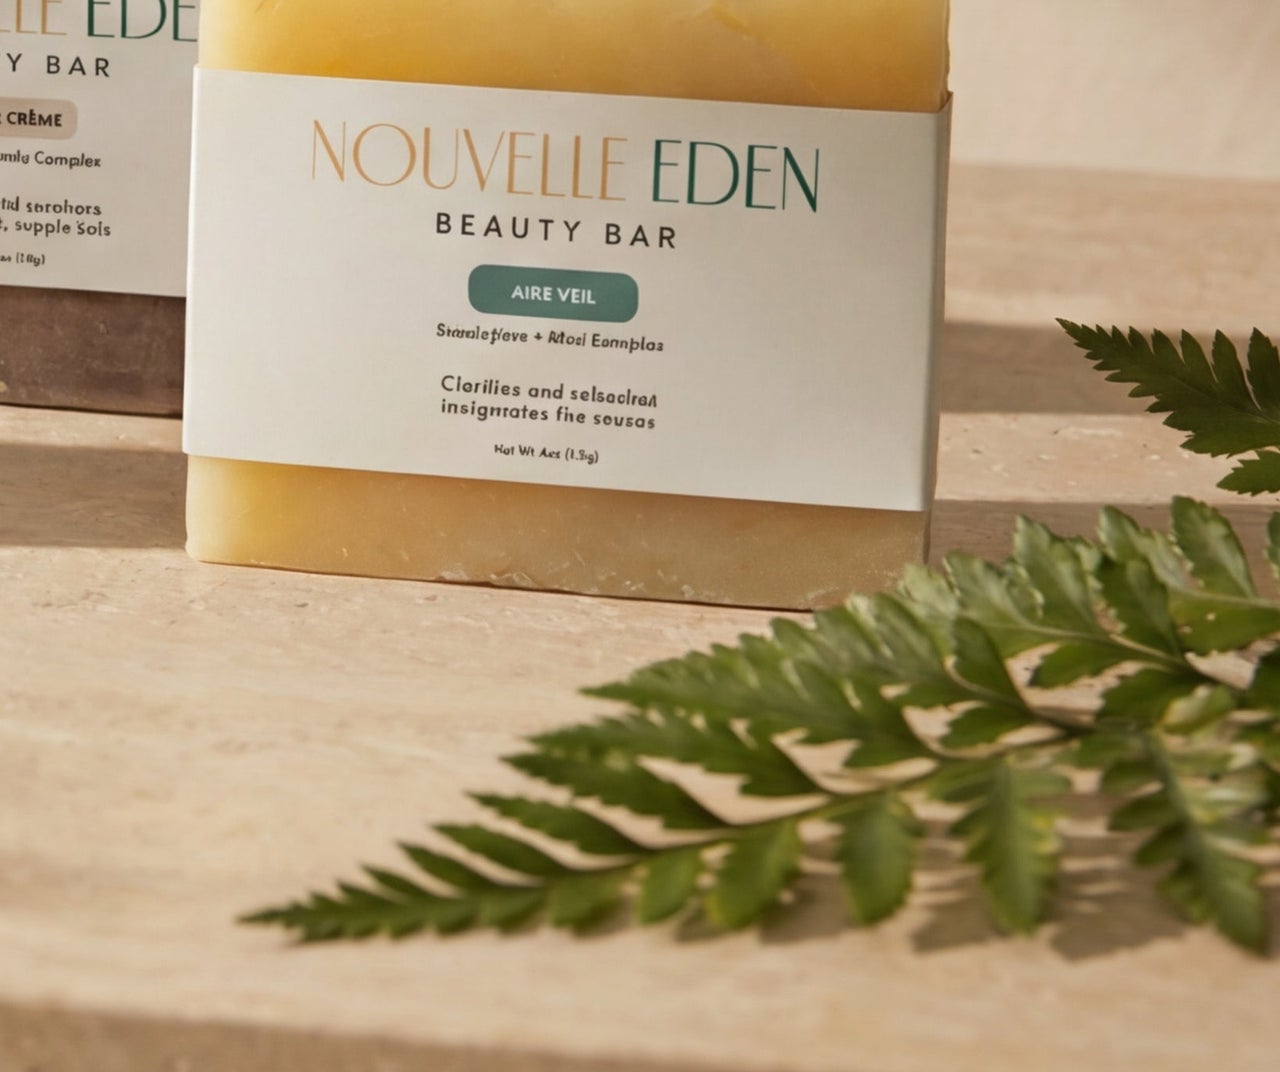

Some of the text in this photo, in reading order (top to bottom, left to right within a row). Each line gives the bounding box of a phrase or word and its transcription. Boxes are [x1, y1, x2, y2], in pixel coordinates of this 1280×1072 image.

[46, 55, 111, 77] BAR
[312, 120, 820, 213] NOUVELLE EDEN
[15, 219, 71, 237] supple
[436, 212, 677, 249] BEAUTY BAR
[511, 284, 596, 305] AIRE VEIL
[528, 384, 564, 399] and
